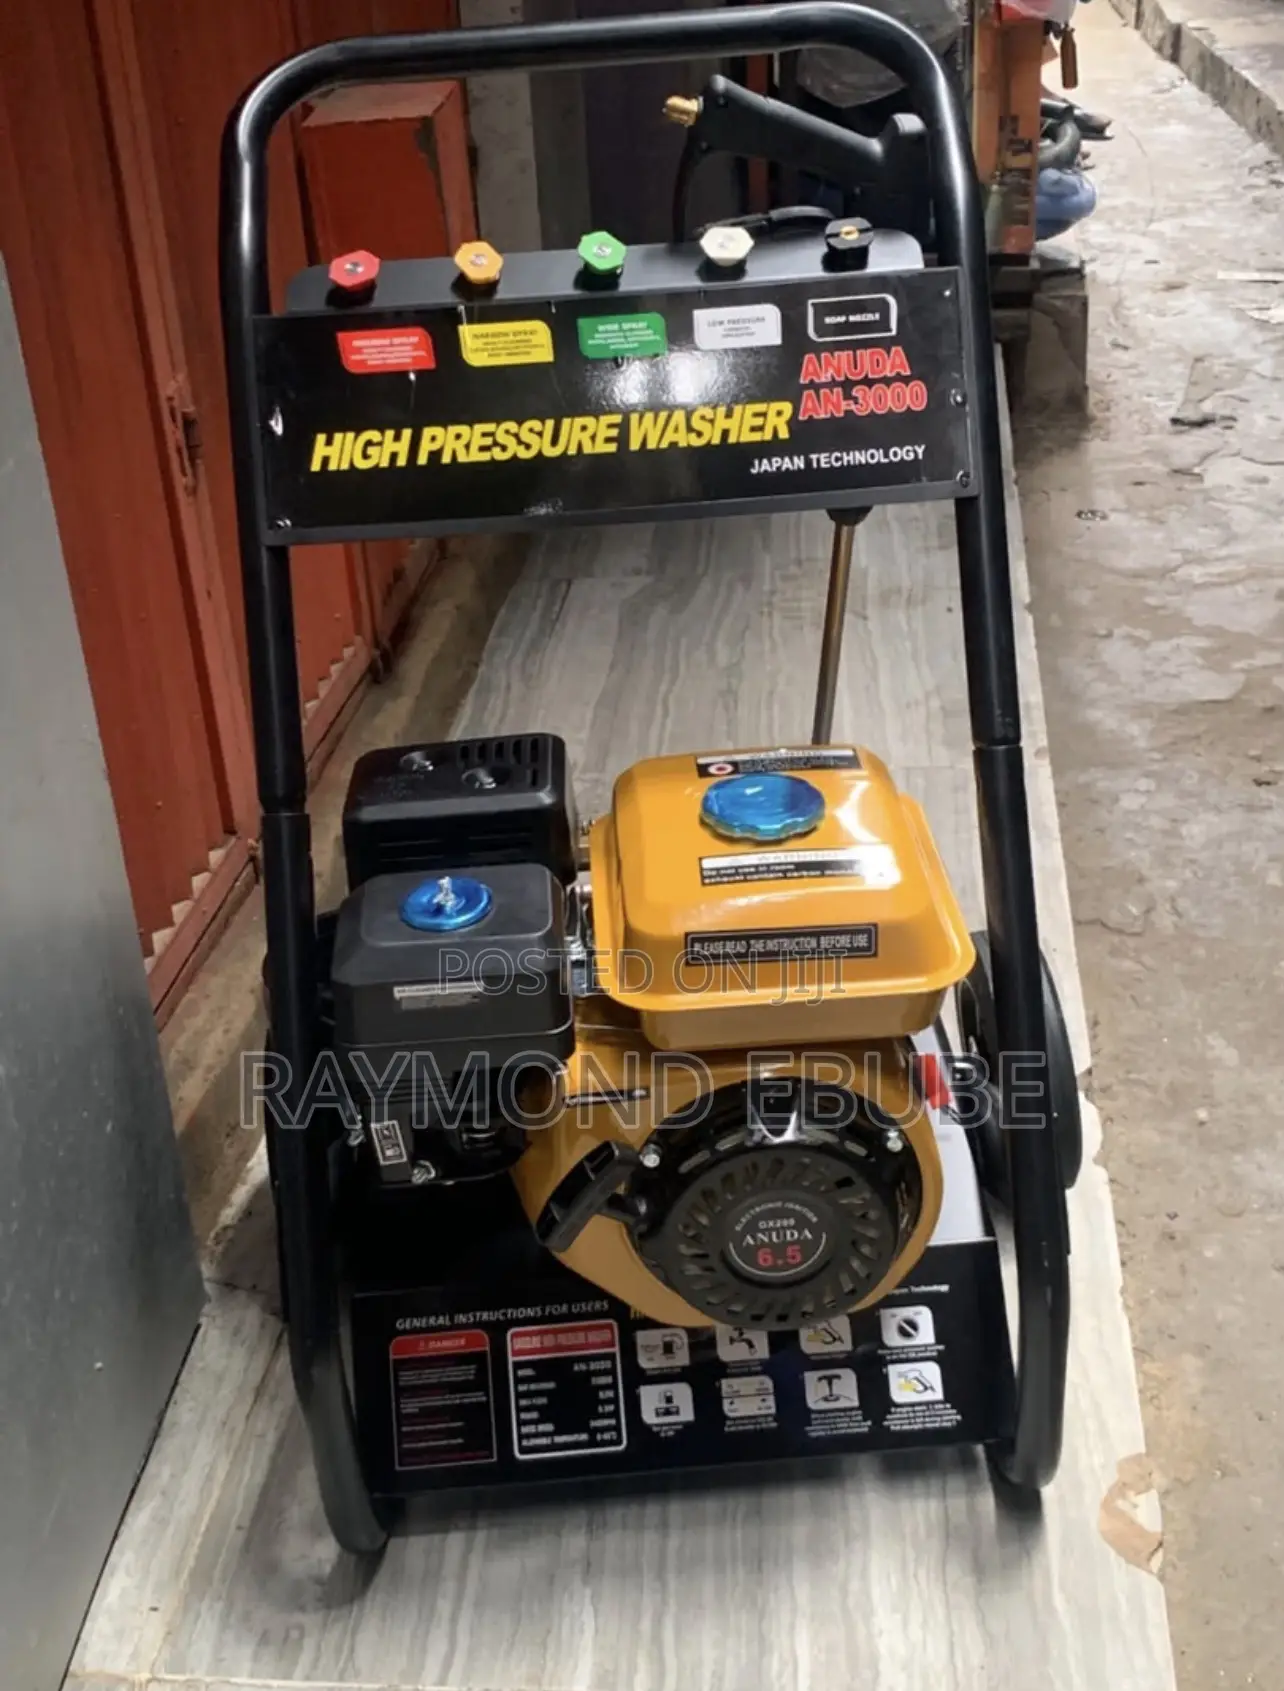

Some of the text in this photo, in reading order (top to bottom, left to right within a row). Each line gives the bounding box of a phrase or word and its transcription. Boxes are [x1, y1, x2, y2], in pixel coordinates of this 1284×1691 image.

[799, 346, 911, 384] ANUDA
[799, 380, 928, 420] AN-3000
[310, 401, 793, 472] HIGH PRESSURE WASHER
[750, 444, 926, 474] JAPAN TECHNOLOGY
[694, 940, 724, 954] PLEASE
[724, 938, 748, 953] READ
[766, 936, 817, 951] INSTRUCTION
[820, 934, 851, 949] BEFORE
[852, 933, 869, 948] USE
[742, 1227, 813, 1247] ANUDA
[758, 1244, 801, 1267] 6.5
[396, 1300, 609, 1330] GENERAL INSTRUCTIONS FOR USERS
